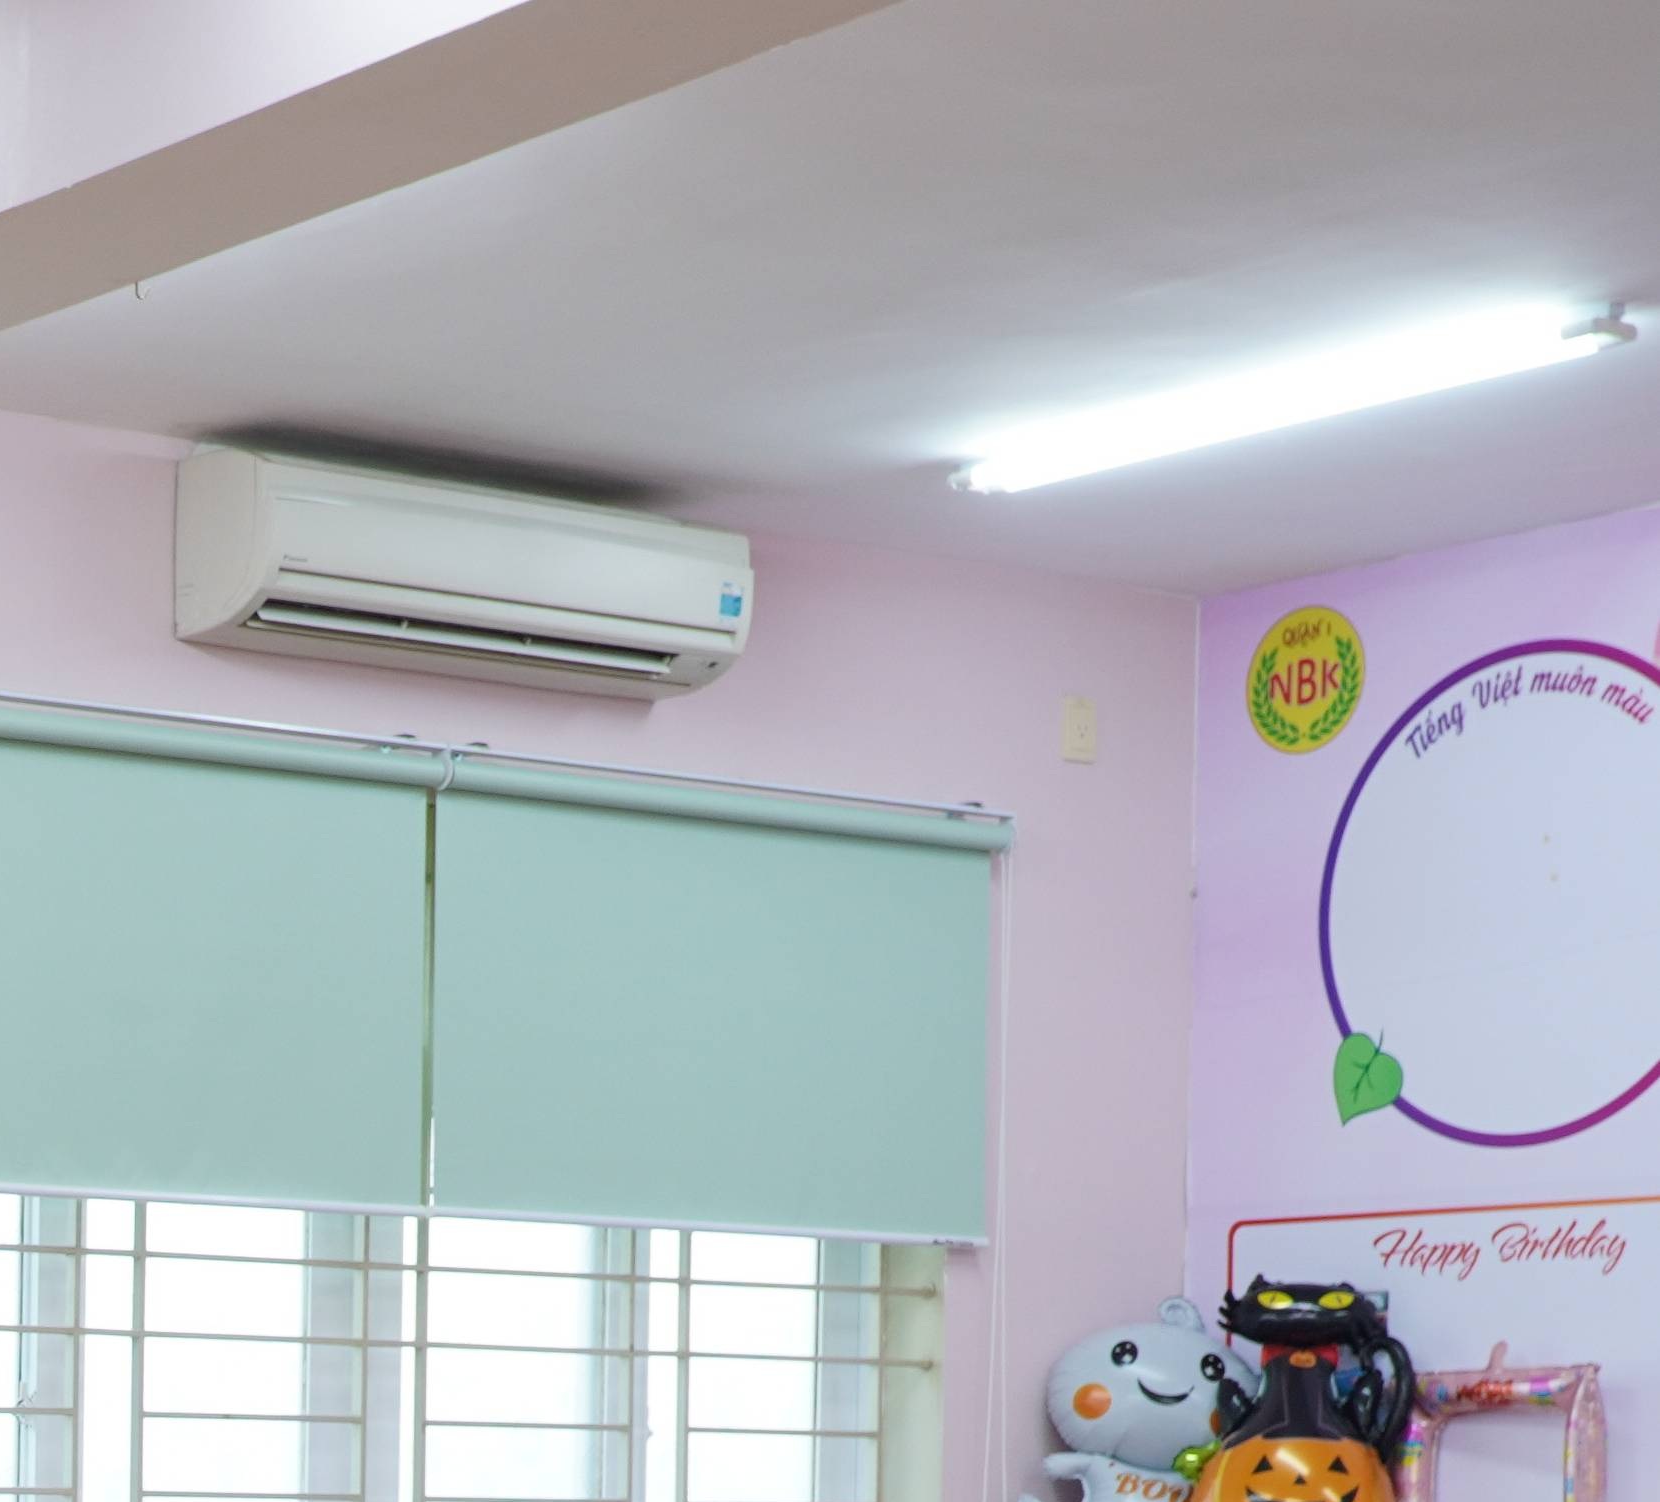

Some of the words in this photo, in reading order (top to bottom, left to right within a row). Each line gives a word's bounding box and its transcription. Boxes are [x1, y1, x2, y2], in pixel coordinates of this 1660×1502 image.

[1270, 658, 1341, 705] NBK
[1405, 702, 1465, 758] Tiếng
[1472, 665, 1524, 708] Việt
[1530, 665, 1598, 696] muôn
[1601, 682, 1654, 724] màu
[1373, 1228, 1481, 1281] Happy
[1492, 1218, 1626, 1275] Birthday
